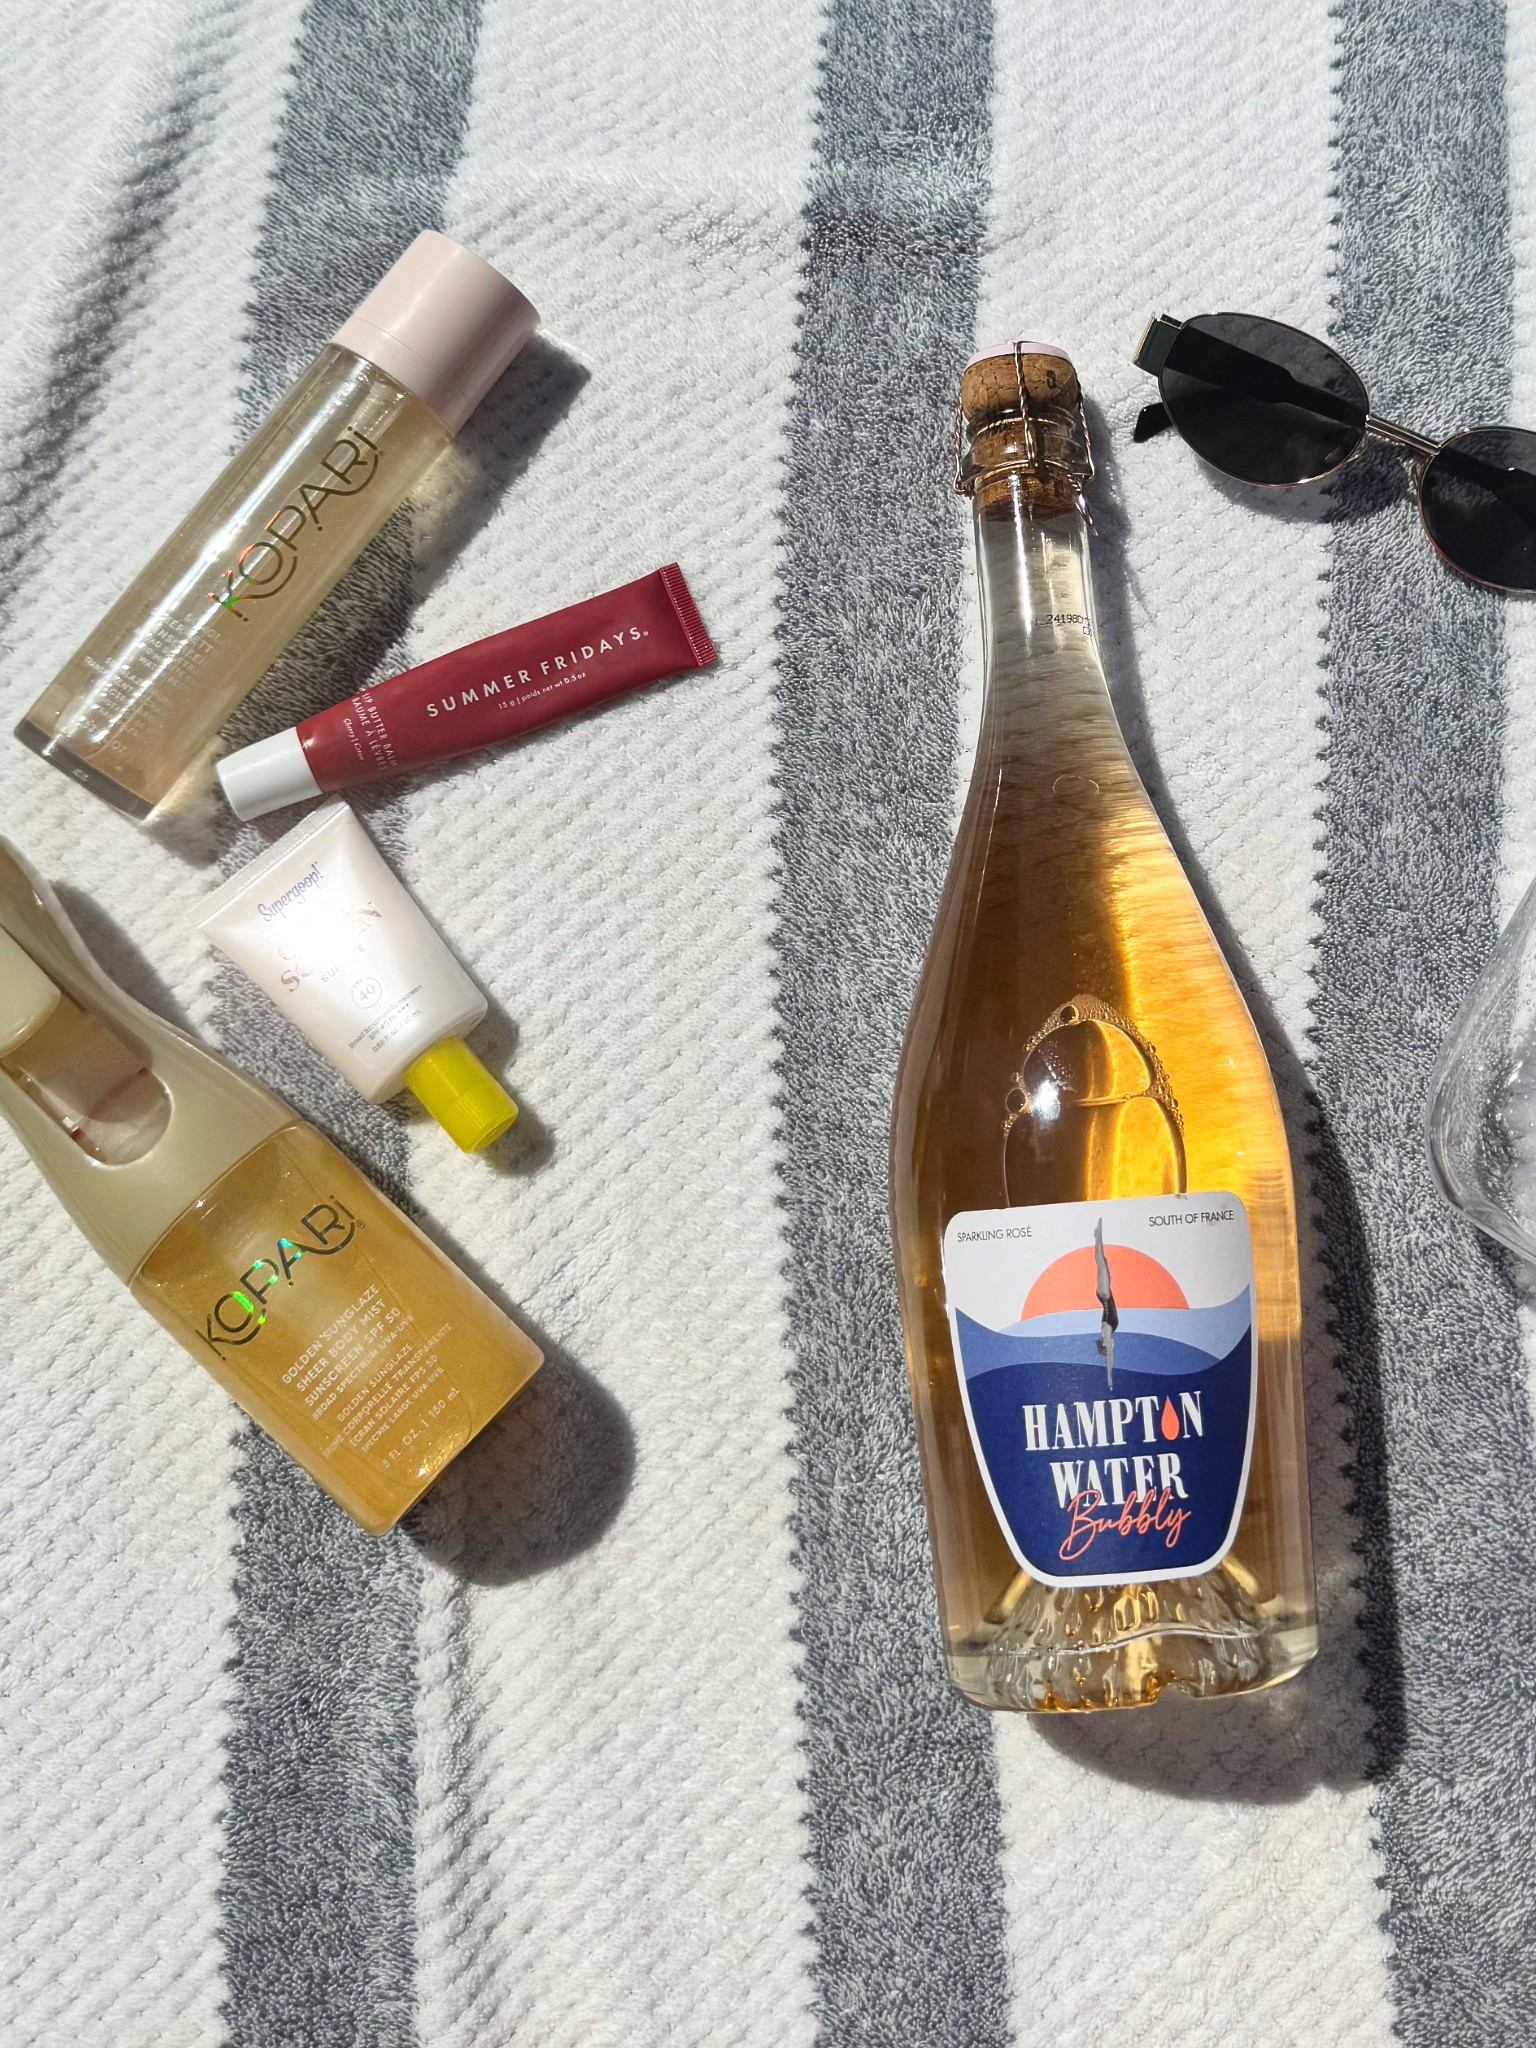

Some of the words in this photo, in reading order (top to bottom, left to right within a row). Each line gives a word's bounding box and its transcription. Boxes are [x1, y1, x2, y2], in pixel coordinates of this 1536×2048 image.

[207, 426, 379, 622] KOPARI
[352, 697, 370, 726] BAUME
[362, 693, 373, 703] LIP
[368, 706, 388, 740] BUTTER
[427, 670, 531, 717] SUMMER
[542, 685, 553, 694] net
[554, 680, 563, 688] wt
[257, 862, 323, 922] Supergoop!
[358, 983, 376, 1001] 40
[957, 1228, 1004, 1243] SPARKLING
[1006, 1226, 1033, 1239] ROSÉ
[1149, 1215, 1182, 1227] SOUTH
[1185, 1213, 1199, 1225] OF
[1201, 1210, 1234, 1223] FRANCE
[196, 1195, 356, 1360] KOPARI
[282, 1340, 323, 1384] GOLDEN
[323, 1284, 380, 1341] SUNGLAZE
[296, 1357, 330, 1392] SHEER
[328, 1325, 360, 1358] BODY
[359, 1298, 386, 1326] MIST
[305, 1343, 365, 1407] SUNSCREEN
[364, 1322, 385, 1344] SPF
[385, 1307, 401, 1324] 50
[312, 1392, 338, 1421] BROAD
[337, 1349, 379, 1393] SPECTRUM
[337, 1386, 370, 1422] GOLDEN
[369, 1343, 414, 1388] SUNGLAZE
[343, 1382, 393, 1435] CORPORELLE
[392, 1322, 452, 1383] TRANSPARENTE
[375, 1384, 411, 1420] SOLAIRE
[409, 1366, 427, 1385] FPS
[426, 1354, 439, 1367] 50
[389, 1398, 414, 1424] LARGE
[412, 1366, 445, 1400] UVA-UVB
[402, 1428, 422, 1446] OZ.
[428, 1400, 447, 1418] 150
[1022, 1391, 1203, 1451] HAMPTON
[1049, 1452, 1189, 1509] WATER
[1058, 1486, 1192, 1561] Bubbly
